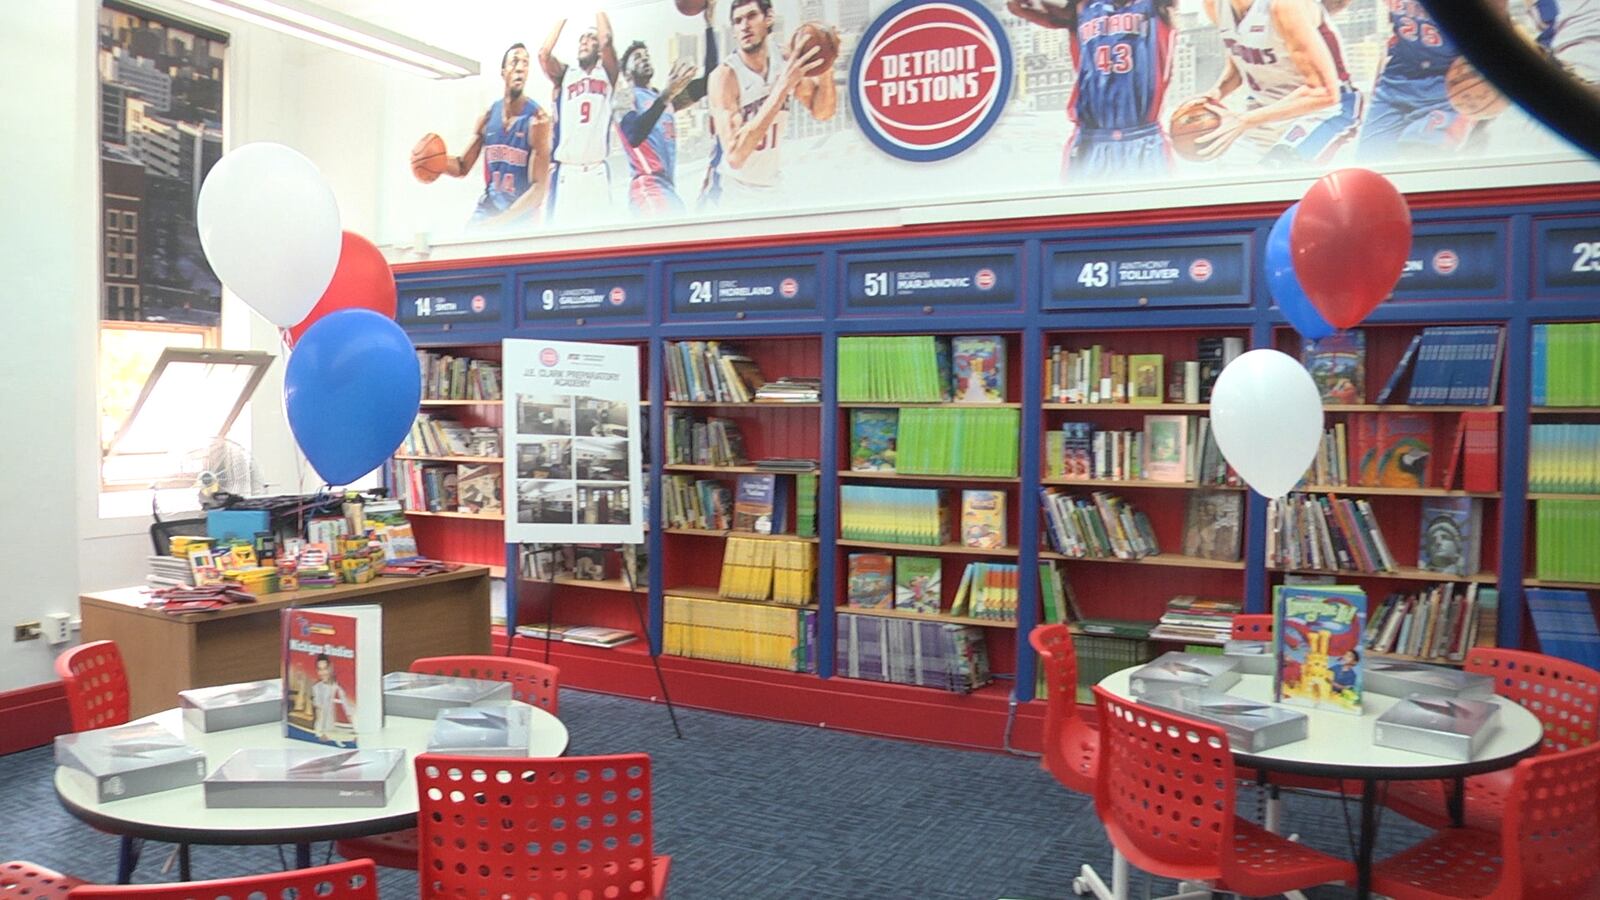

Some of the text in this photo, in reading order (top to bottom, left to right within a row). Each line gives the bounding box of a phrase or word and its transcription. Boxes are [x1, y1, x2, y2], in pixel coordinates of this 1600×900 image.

[881, 45, 978, 79] DETROIT
[1095, 43, 1134, 74] 43
[880, 72, 979, 107] PISTONS
[580, 101, 592, 124] 9
[492, 171, 516, 193] 14
[864, 272, 888, 297] 51
[896, 277, 971, 290] MARJANOVIC
[1077, 262, 1110, 288] 43
[1119, 268, 1181, 281] TOLLIVER
[542, 289, 554, 310] 9
[688, 280, 713, 304] 24
[718, 286, 775, 297] MORELAND
[415, 297, 431, 317] 14
